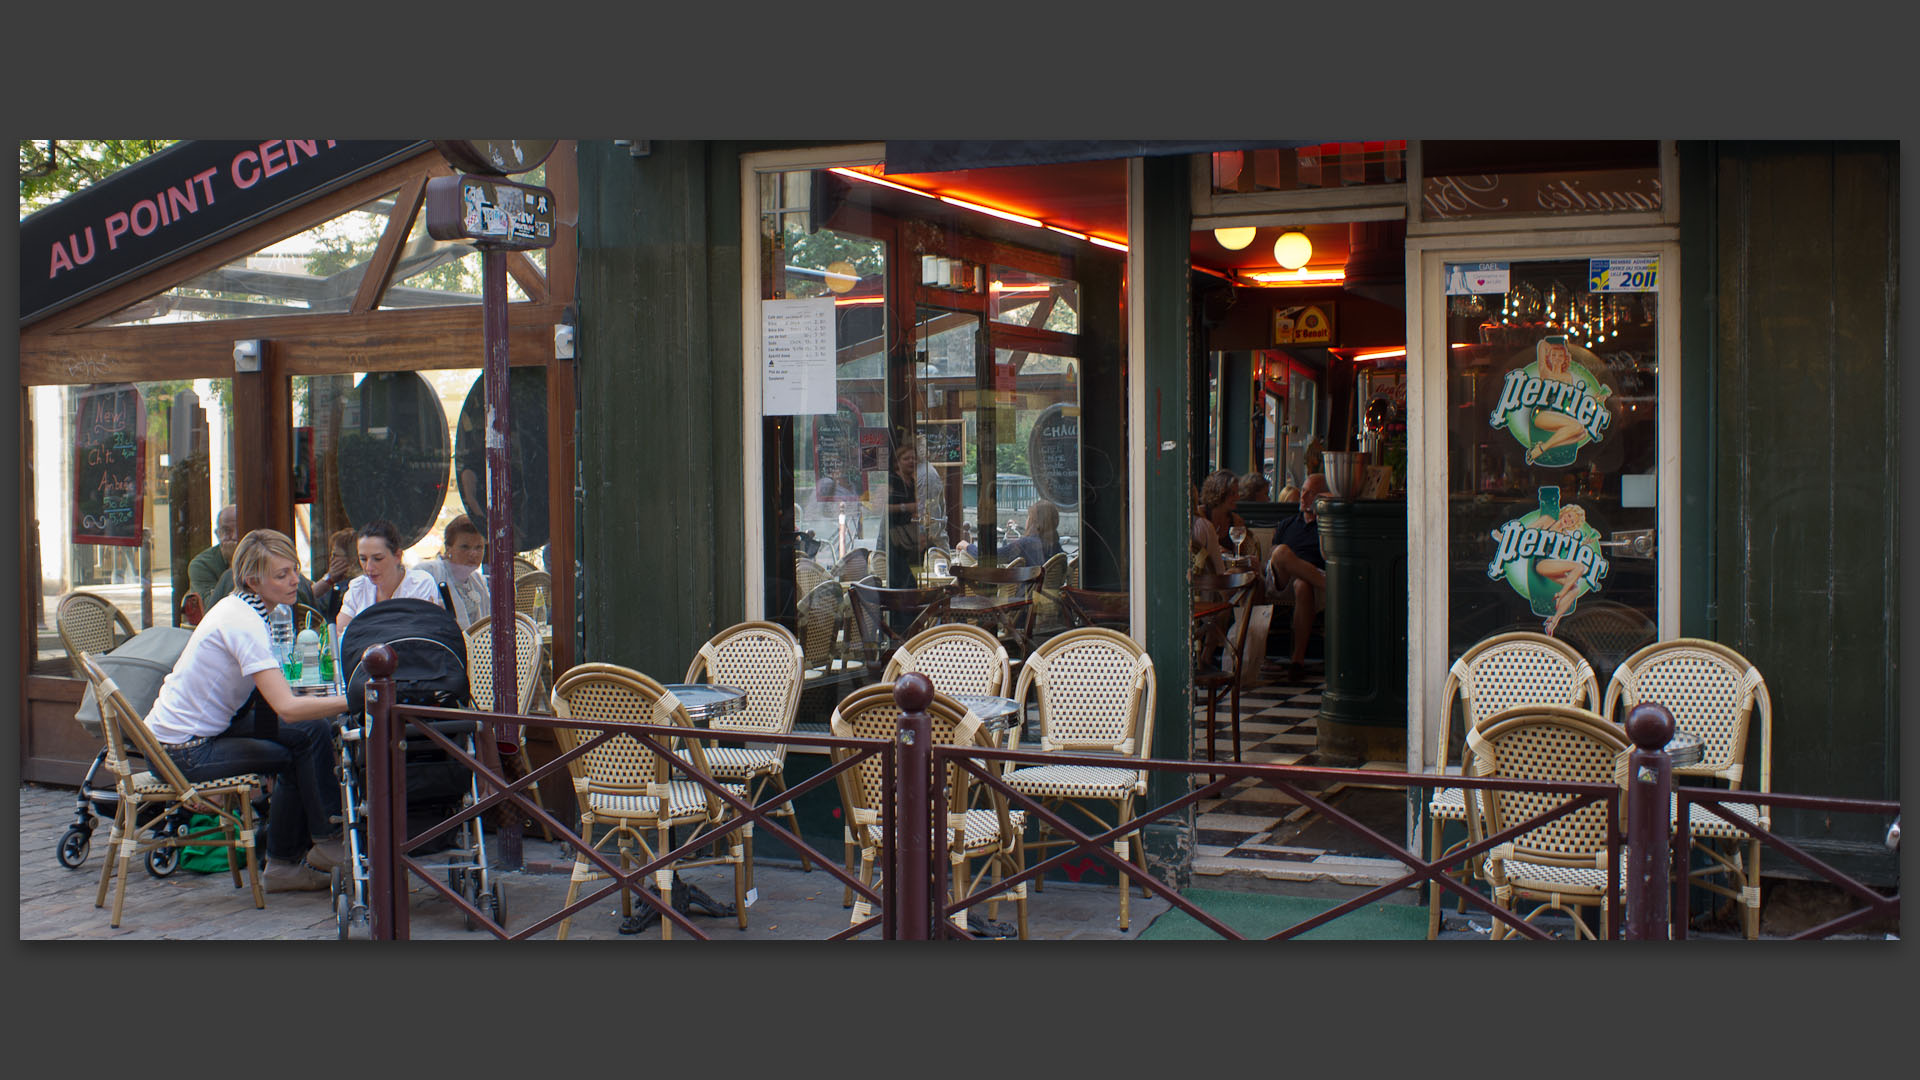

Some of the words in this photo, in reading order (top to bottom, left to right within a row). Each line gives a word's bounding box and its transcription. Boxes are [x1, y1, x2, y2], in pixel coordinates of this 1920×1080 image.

[50, 226, 96, 279] AU
[105, 166, 218, 250] POINT
[231, 140, 337, 189] CEN
[1619, 271, 1657, 288] 2011
